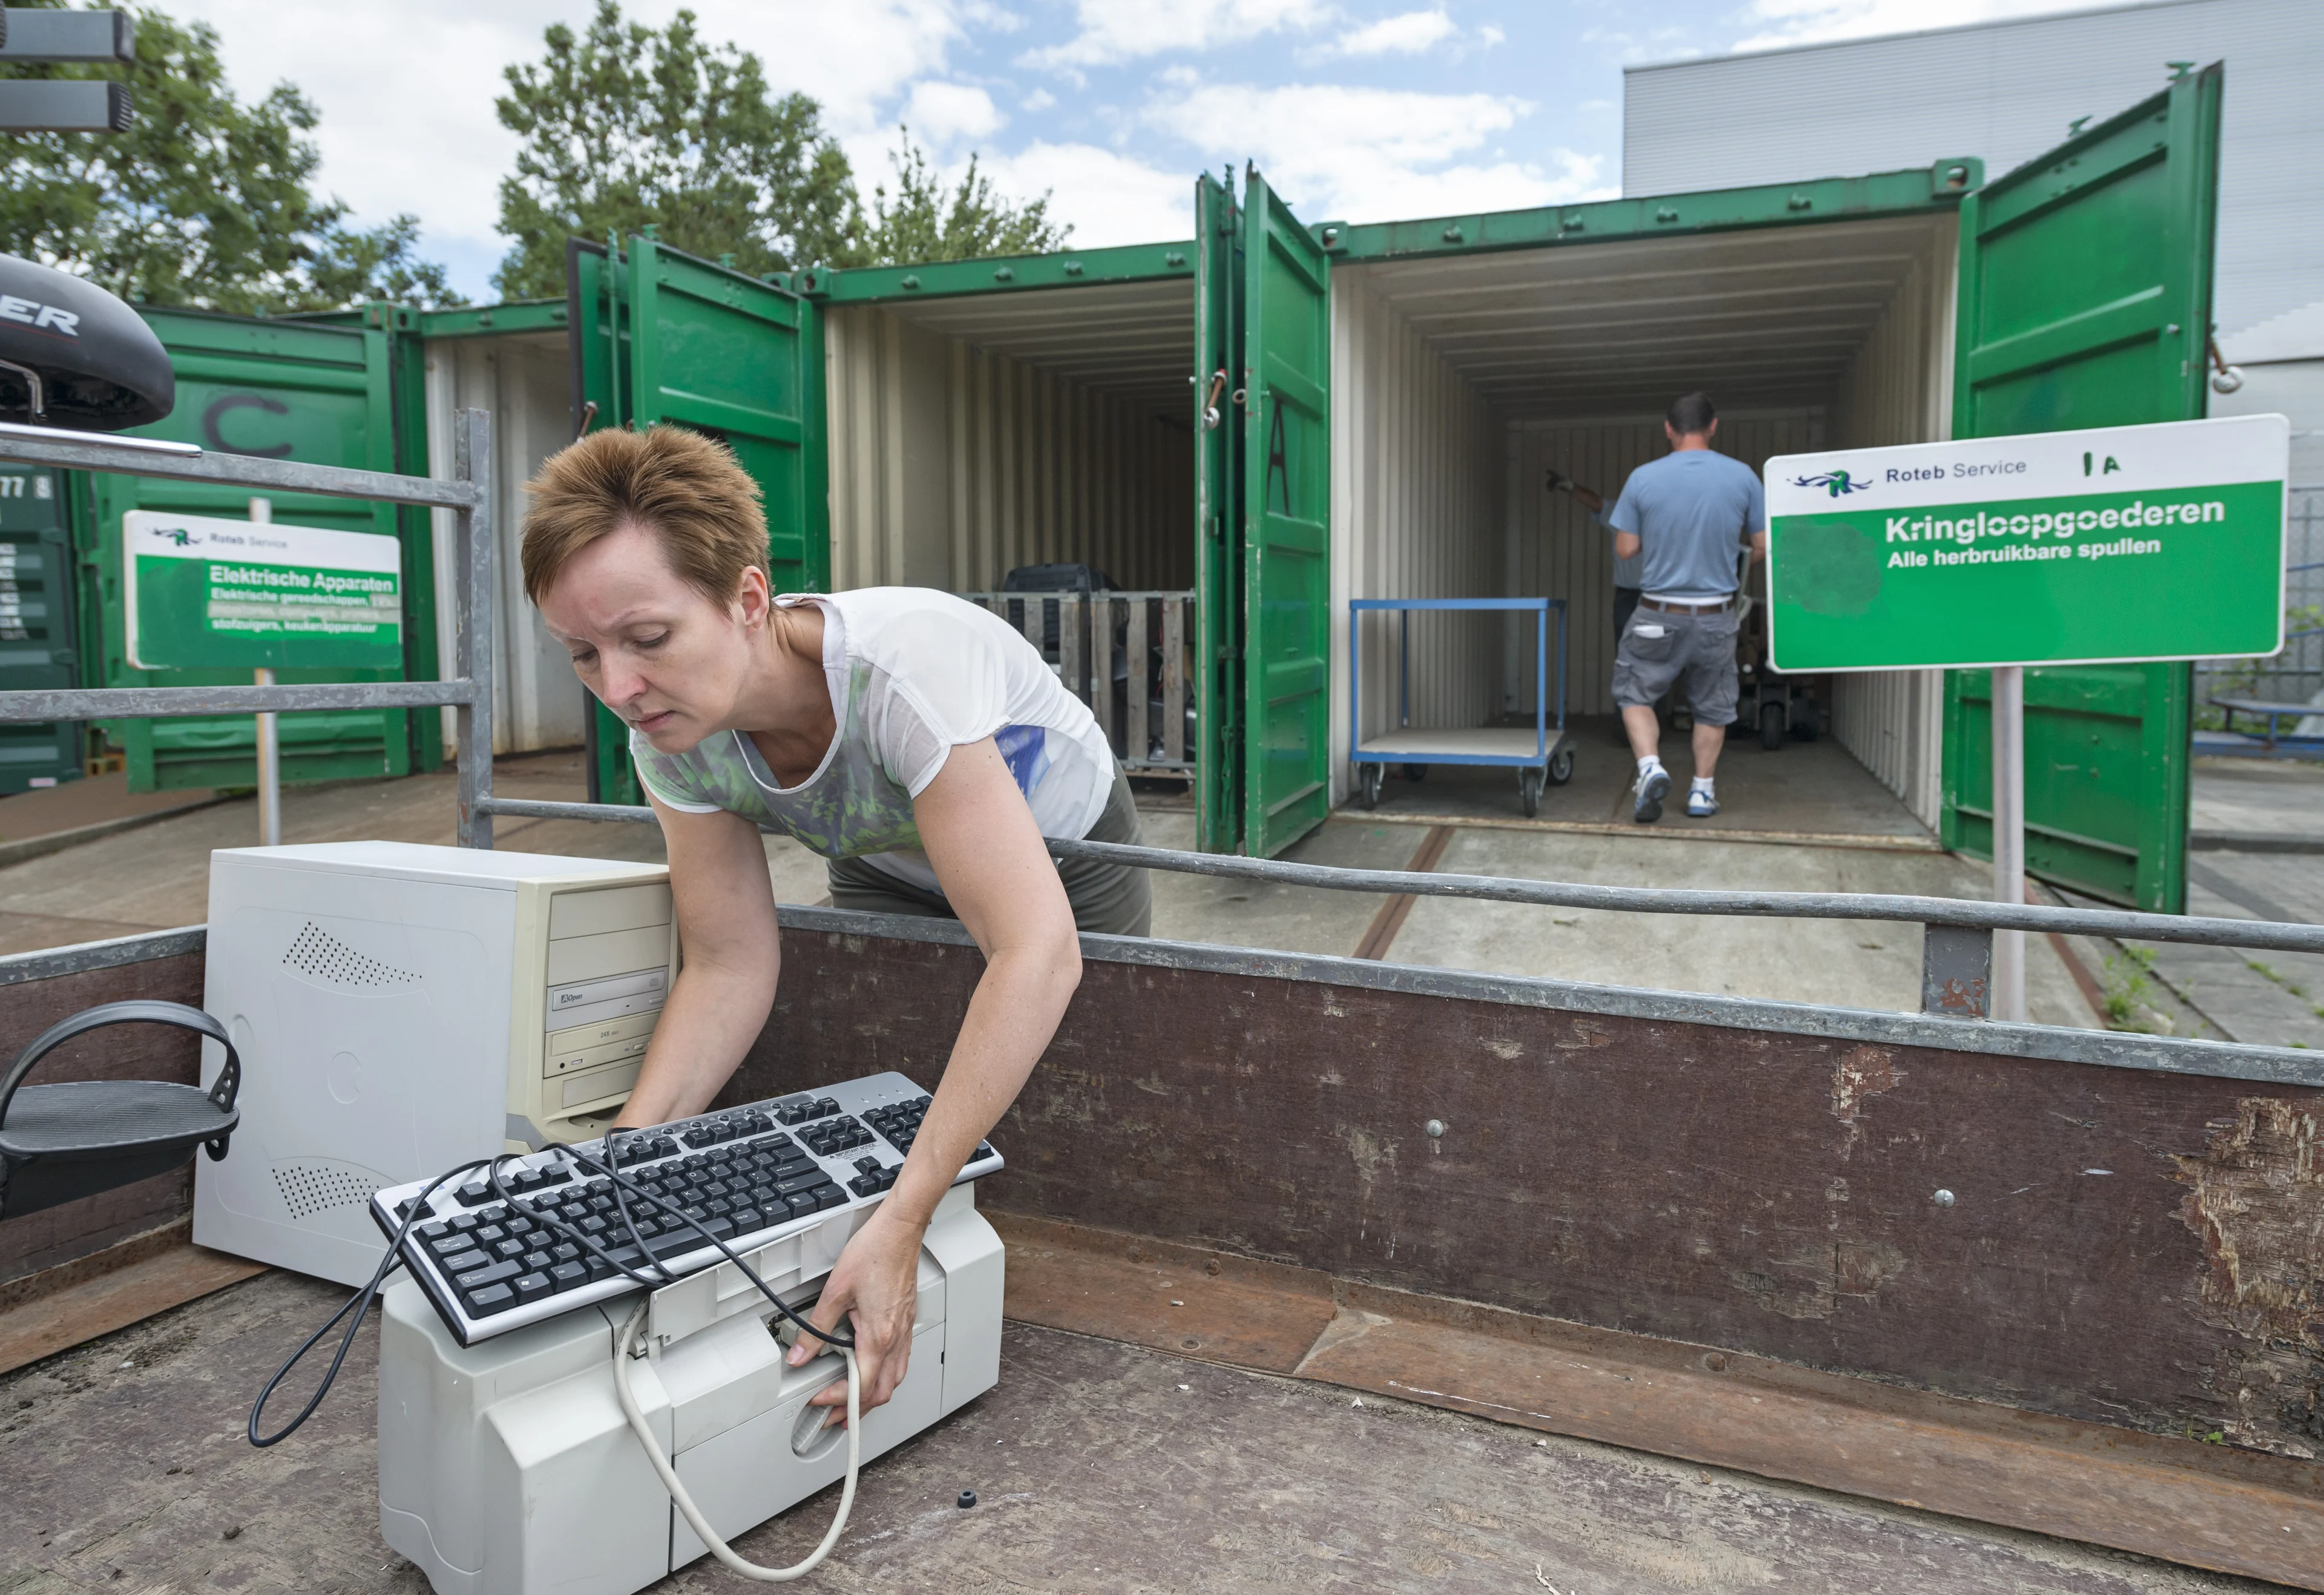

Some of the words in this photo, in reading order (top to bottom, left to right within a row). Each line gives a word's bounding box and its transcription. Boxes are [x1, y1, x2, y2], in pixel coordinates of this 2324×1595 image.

[1886, 465, 1945, 483] Roteb
[1953, 460, 2027, 478] Service
[1885, 500, 2225, 545] Kringloopgoederen
[209, 532, 245, 544] Roteb
[249, 535, 288, 549] Service
[1886, 550, 1928, 568] Alle
[1933, 543, 2072, 566] herbruikbare
[2077, 537, 2161, 560] spullen
[209, 565, 311, 588] Elektrische
[313, 572, 393, 593] Apparaten
[835, 1147, 860, 1156] IMPORTANT
